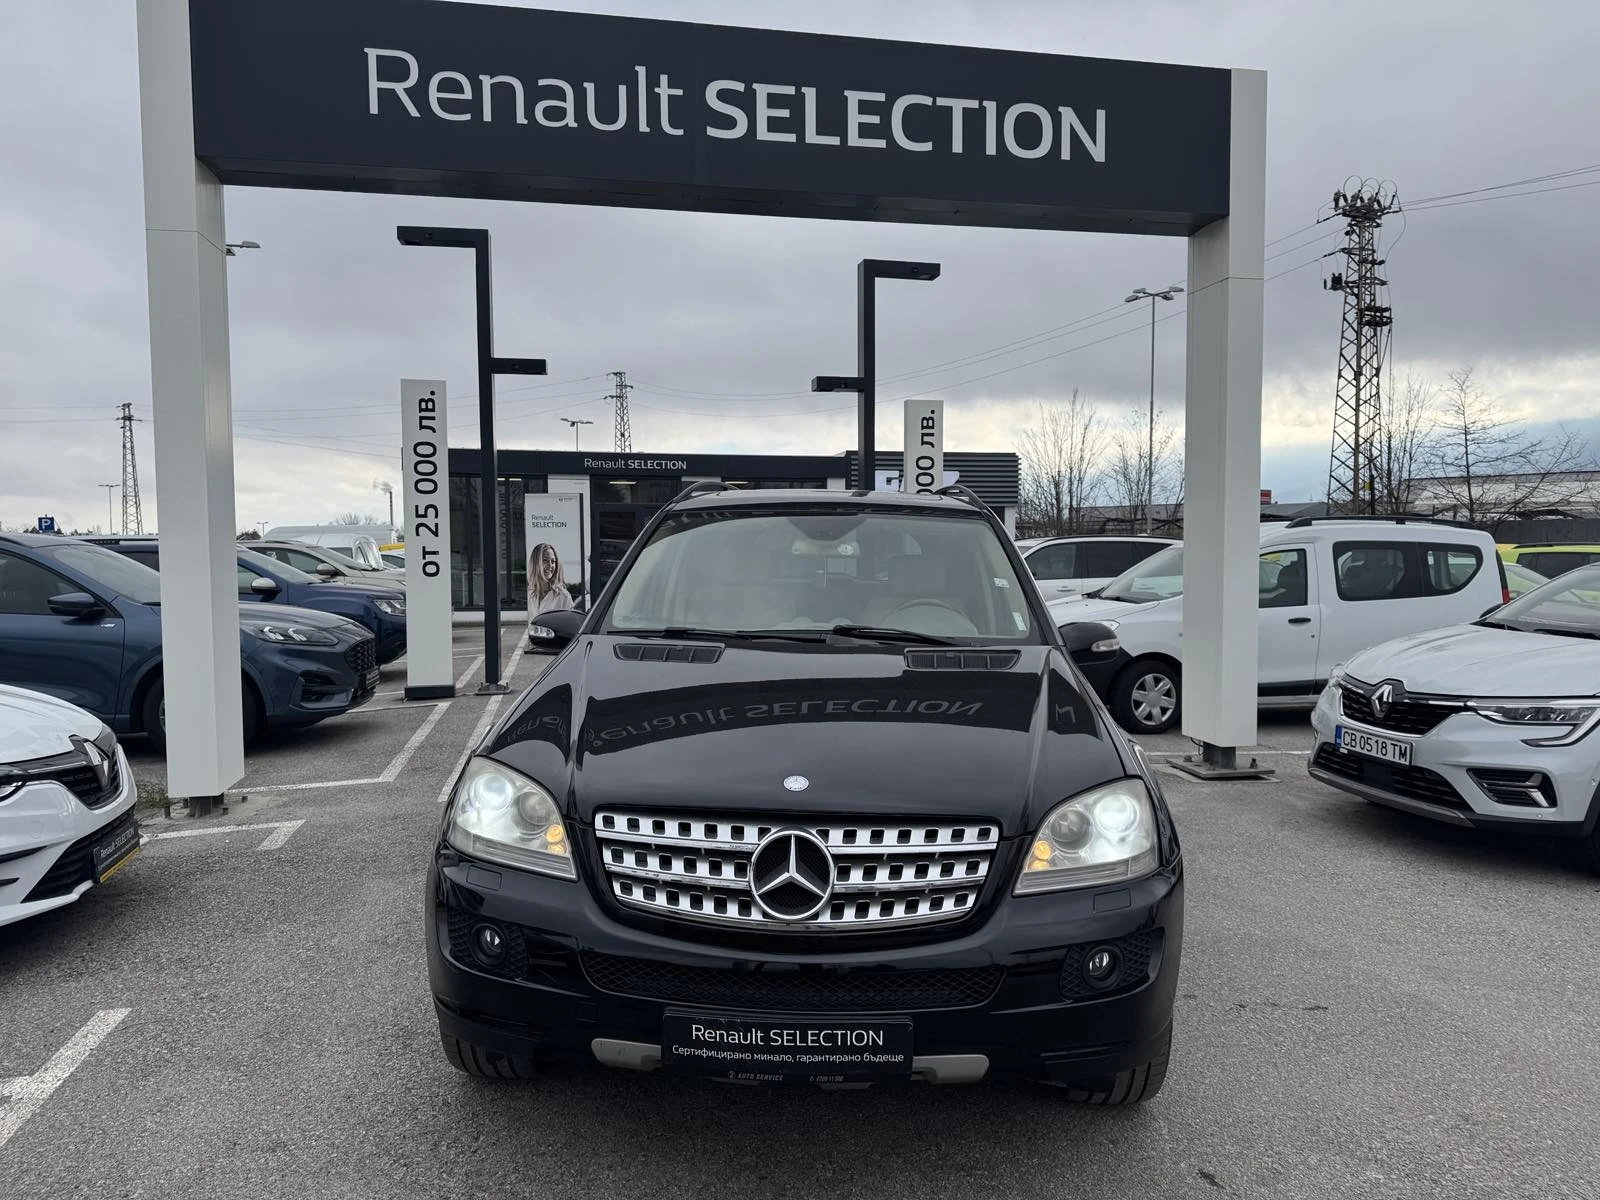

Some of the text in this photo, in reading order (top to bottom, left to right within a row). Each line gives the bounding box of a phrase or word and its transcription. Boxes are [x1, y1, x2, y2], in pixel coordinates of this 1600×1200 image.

[364, 47, 1106, 163] Renault SELECTION
[920, 409, 935, 448] лв.
[584, 458, 687, 470] Renault SELECTION
[413, 390, 440, 578] от 25 000 лв.
[41, 518, 51, 529] P
[1343, 731, 1407, 762] CB 0518 TM
[691, 1024, 883, 1047] Renault SELECTION
[672, 1045, 904, 1064] Сертифицирано минало, гарантирано бъдеще
